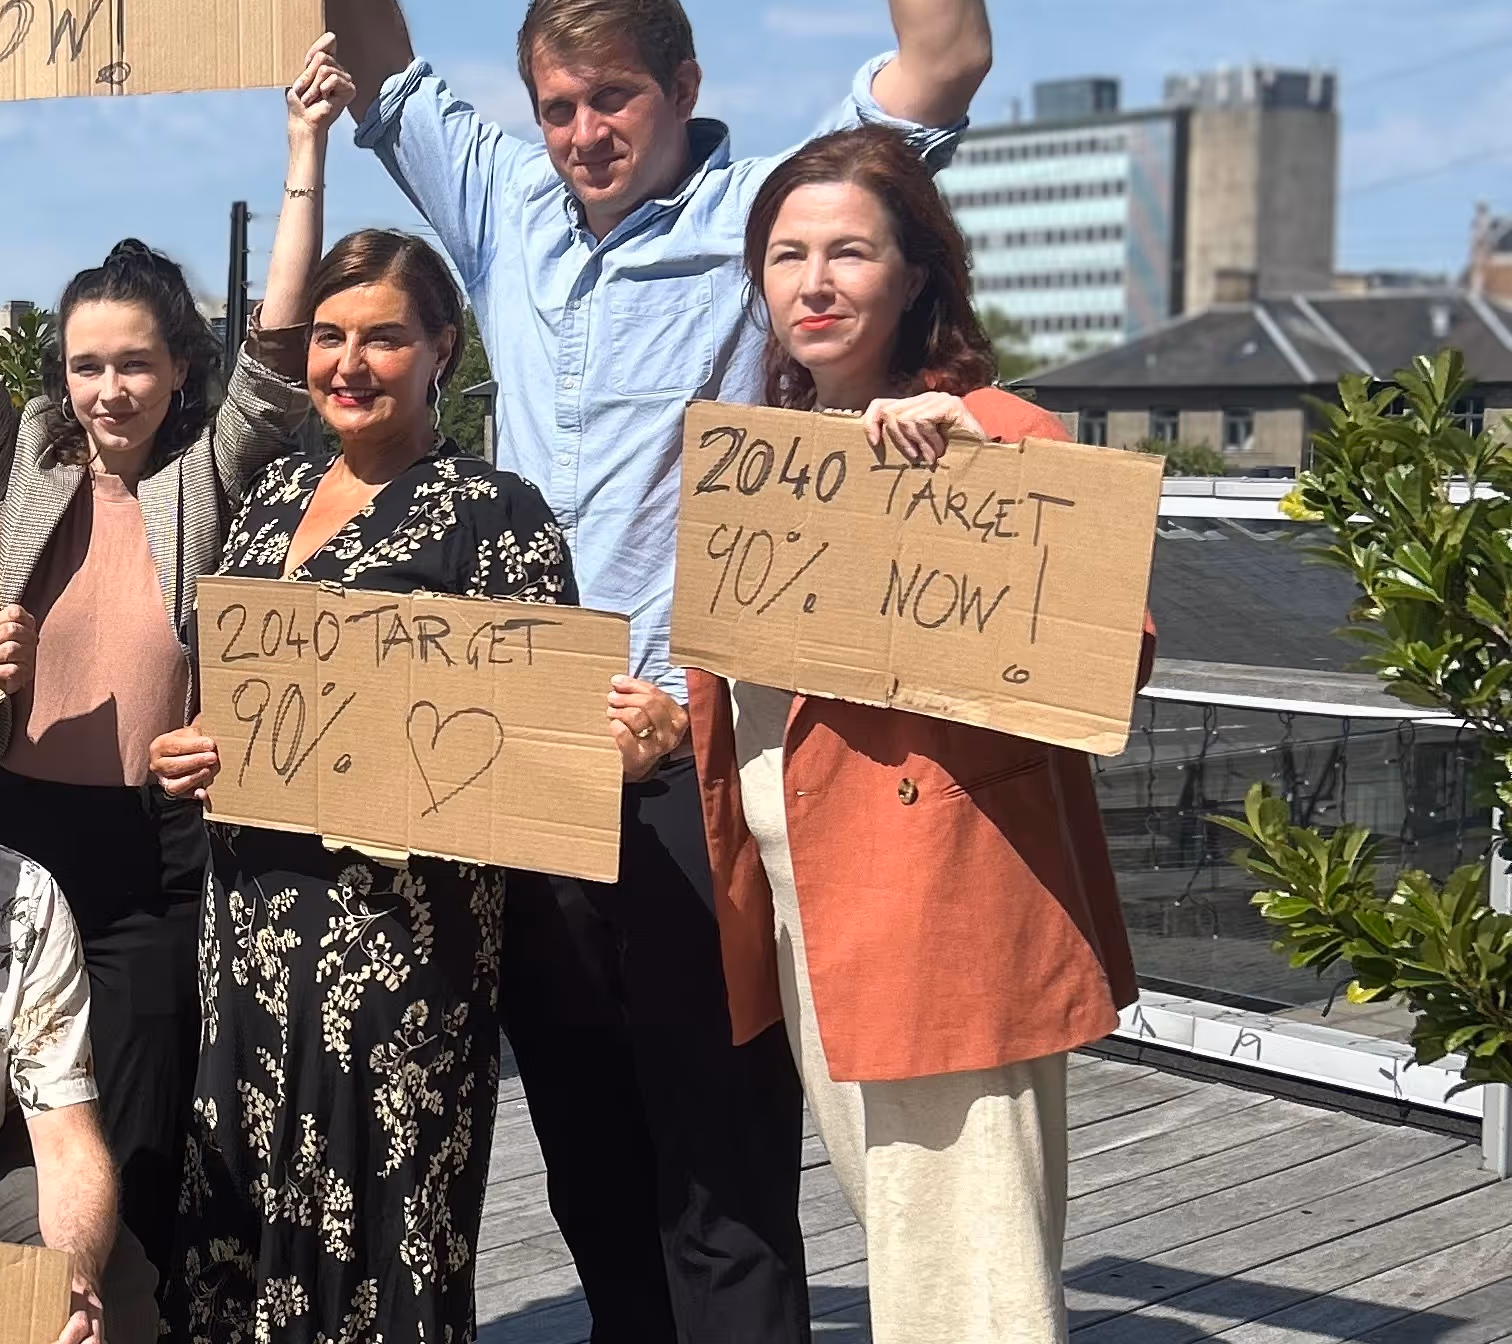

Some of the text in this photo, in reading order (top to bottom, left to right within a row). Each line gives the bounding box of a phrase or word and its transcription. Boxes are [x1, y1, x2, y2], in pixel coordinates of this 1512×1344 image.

[693, 426, 1076, 547] 2040 TARGET
[217, 604, 563, 670] 2040 TARGET
[706, 524, 1048, 684] 90% NOW!
[232, 678, 356, 787] 90%
